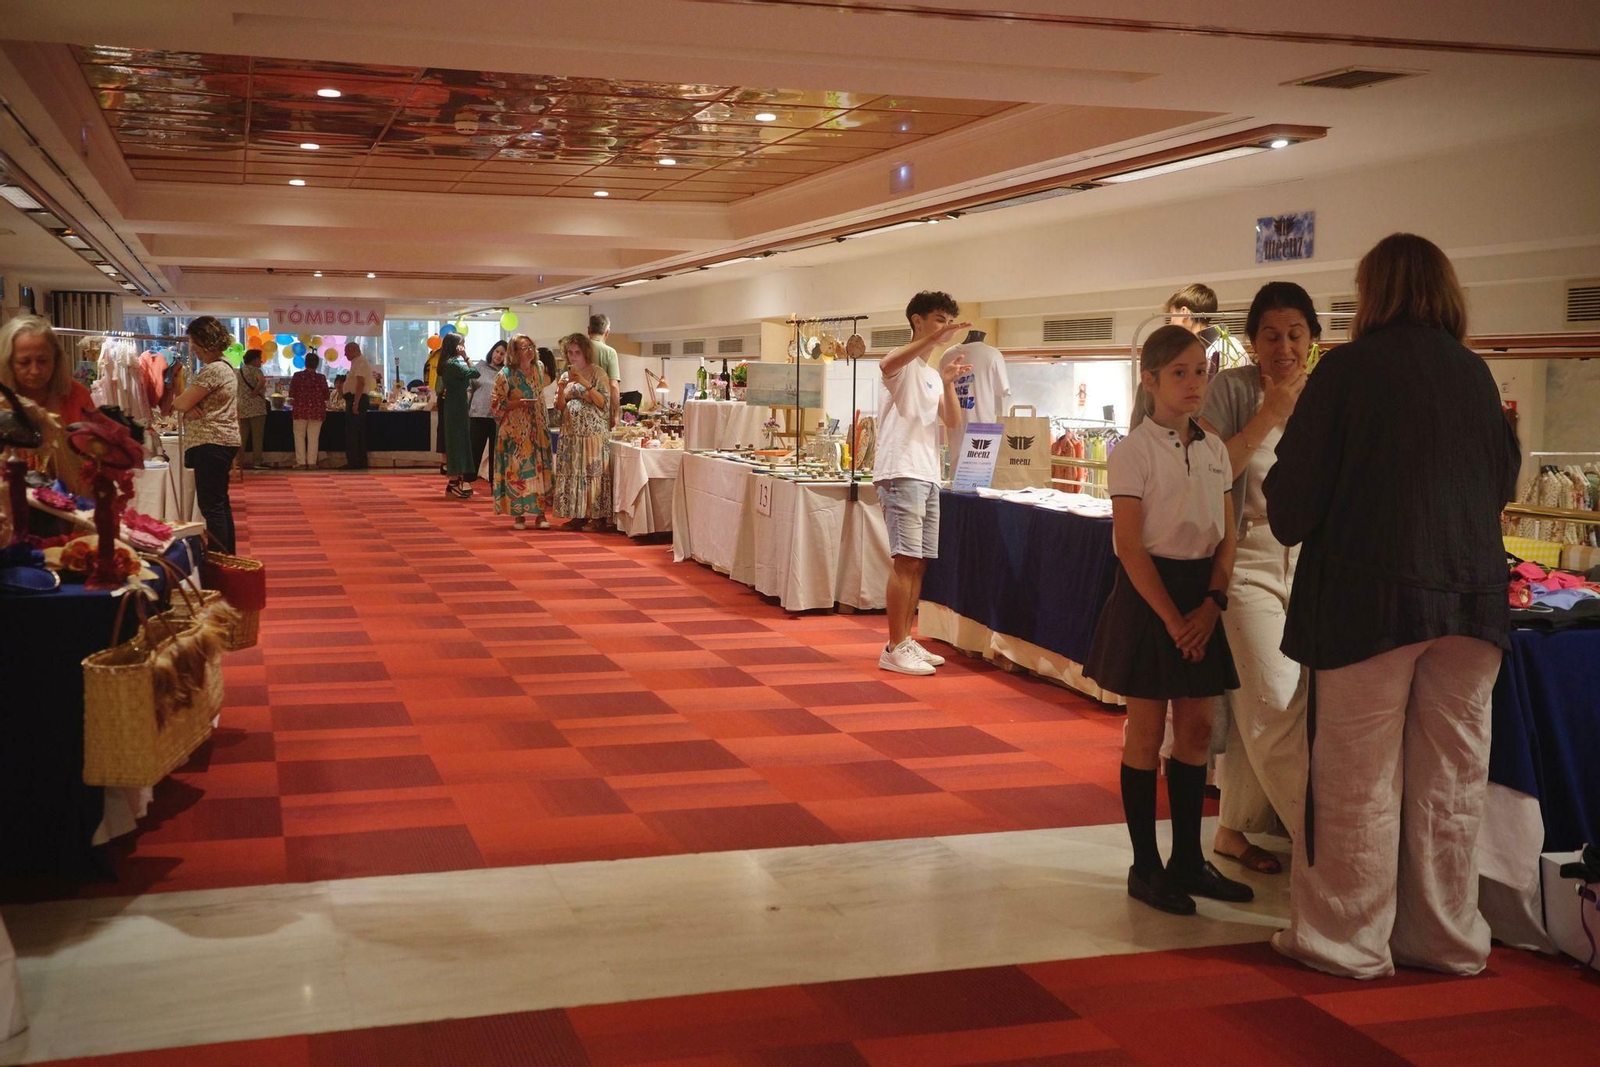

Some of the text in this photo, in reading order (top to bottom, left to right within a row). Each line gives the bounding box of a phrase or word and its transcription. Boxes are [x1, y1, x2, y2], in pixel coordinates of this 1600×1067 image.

[1264, 236, 1303, 260] meenz
[273, 304, 381, 326] TÓMBOLA
[966, 450, 991, 459] meenz
[1009, 458, 1031, 466] meenz
[759, 483, 768, 508] 13
